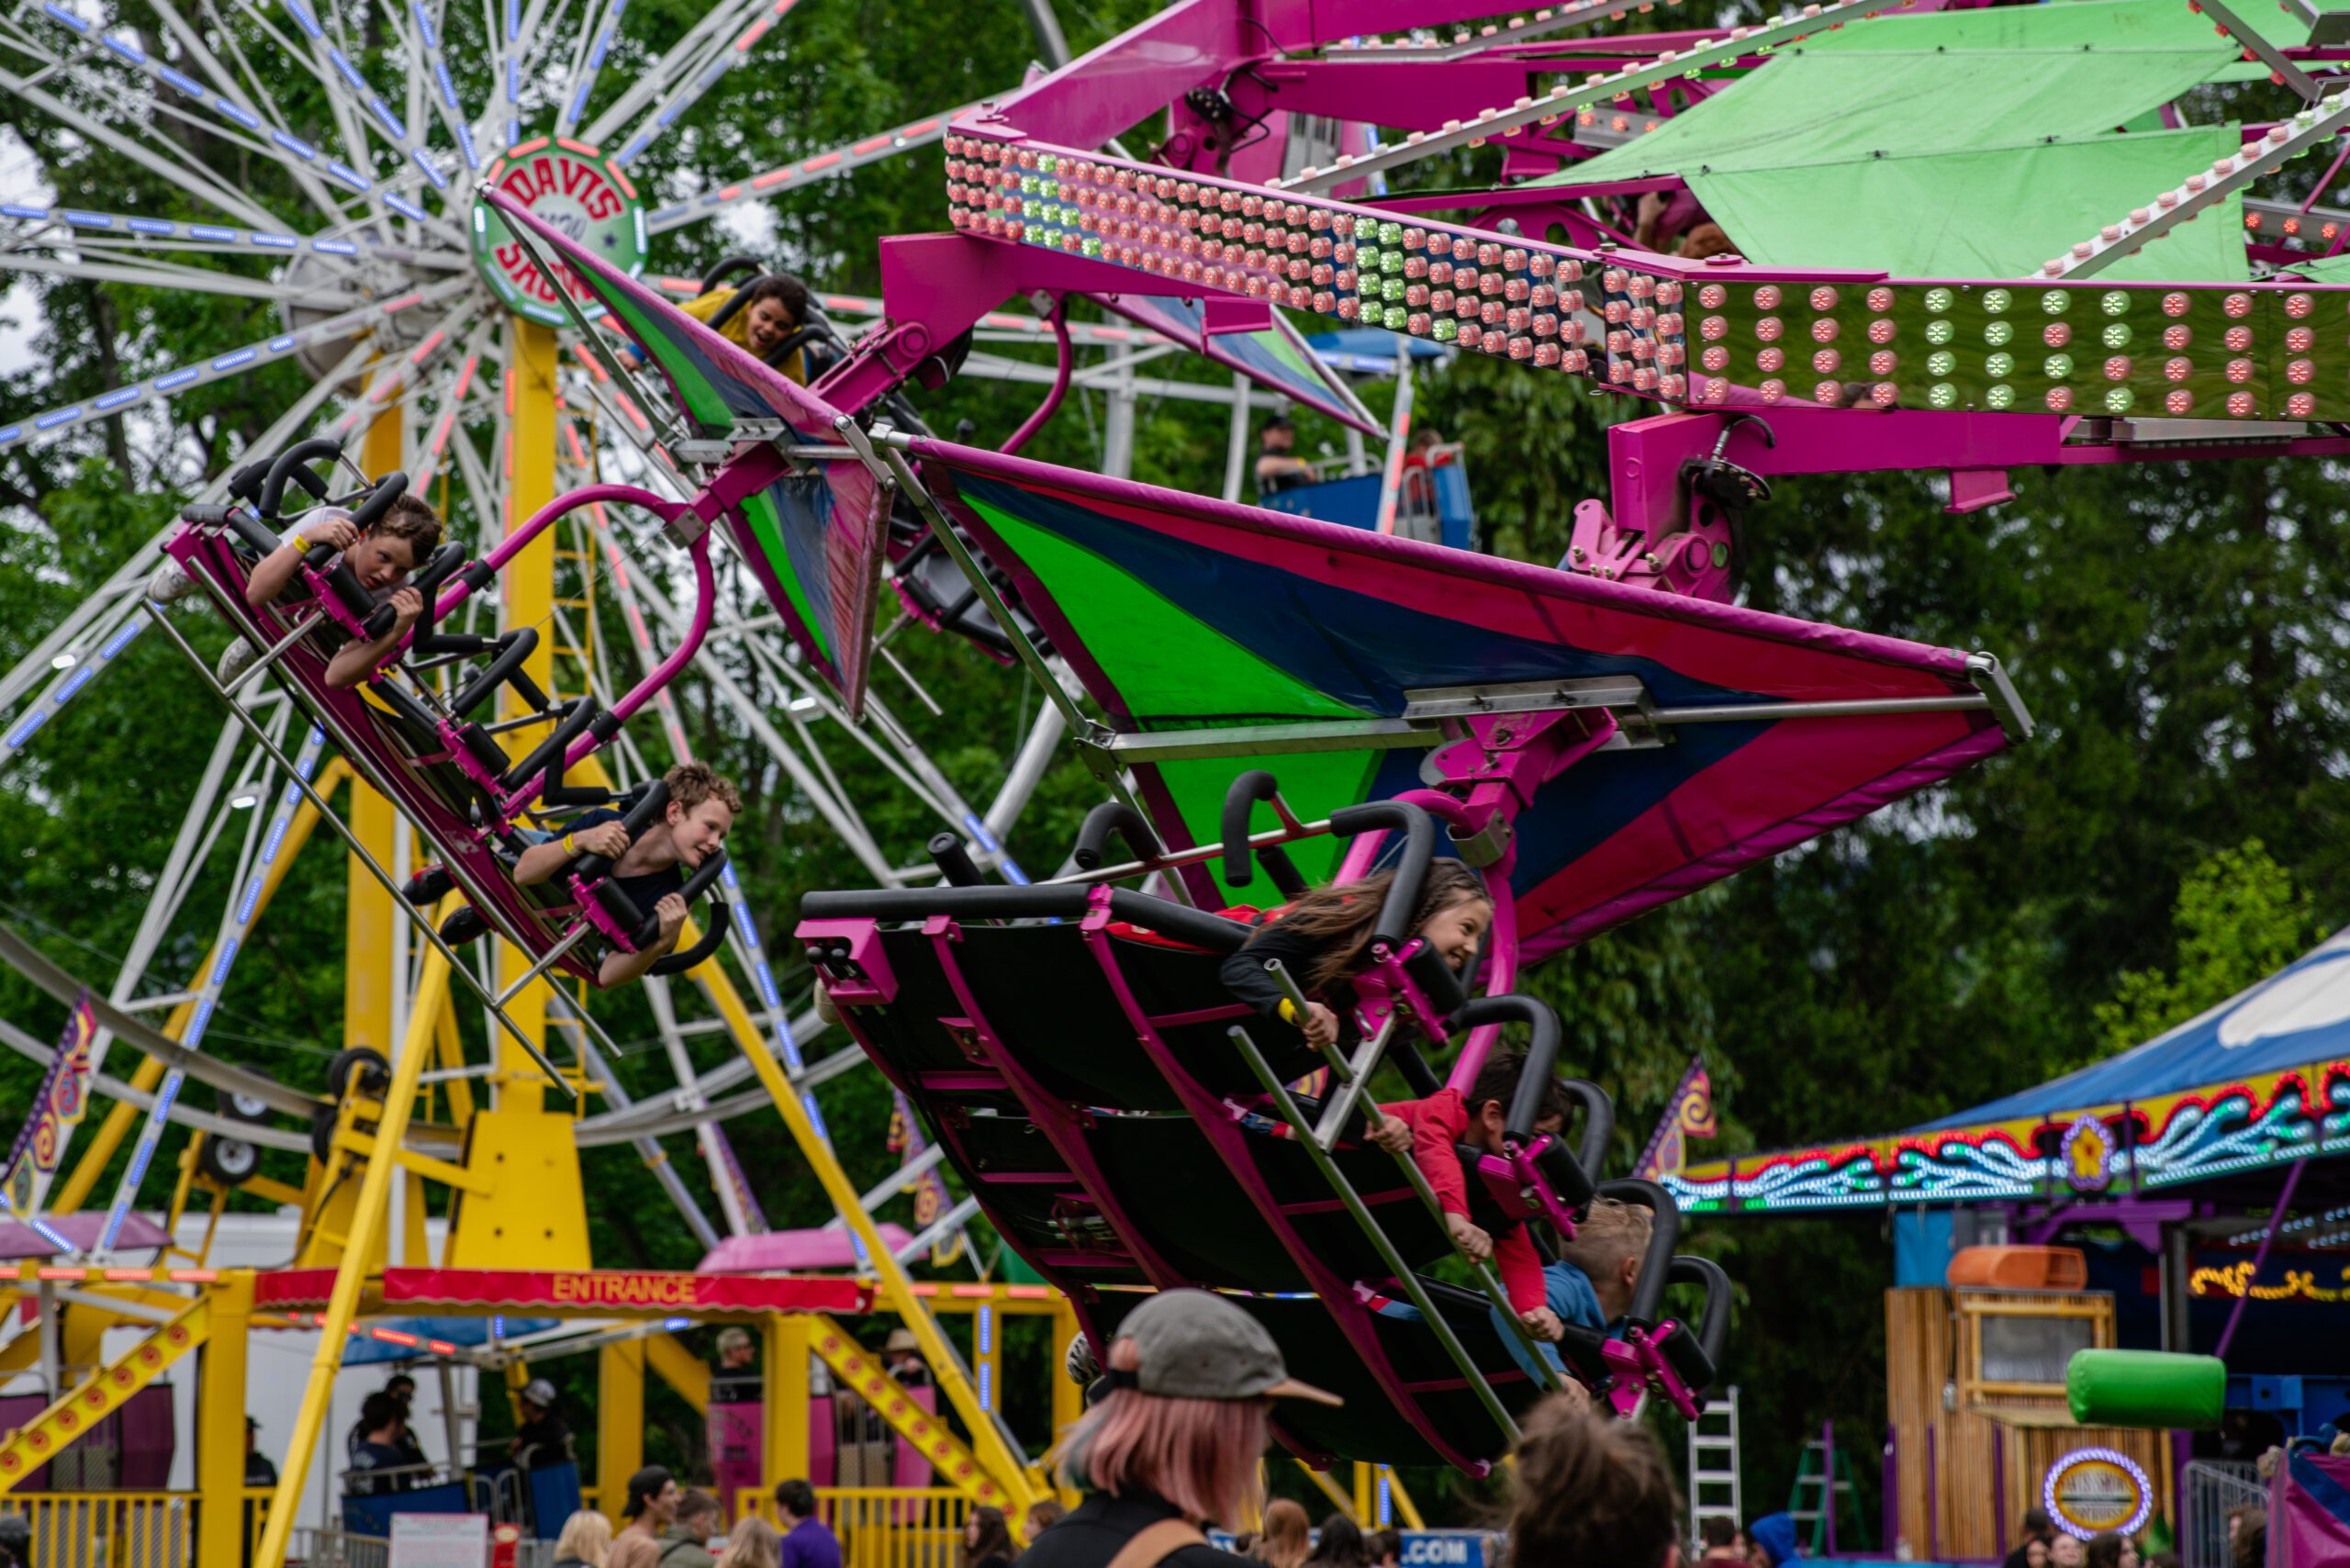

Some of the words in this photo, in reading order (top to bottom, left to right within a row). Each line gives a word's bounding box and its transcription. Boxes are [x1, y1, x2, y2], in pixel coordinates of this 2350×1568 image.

[500, 157, 623, 221] DAVIS
[553, 1274, 698, 1304] ENTRANCE
[1401, 1539, 1468, 1563] .COM
